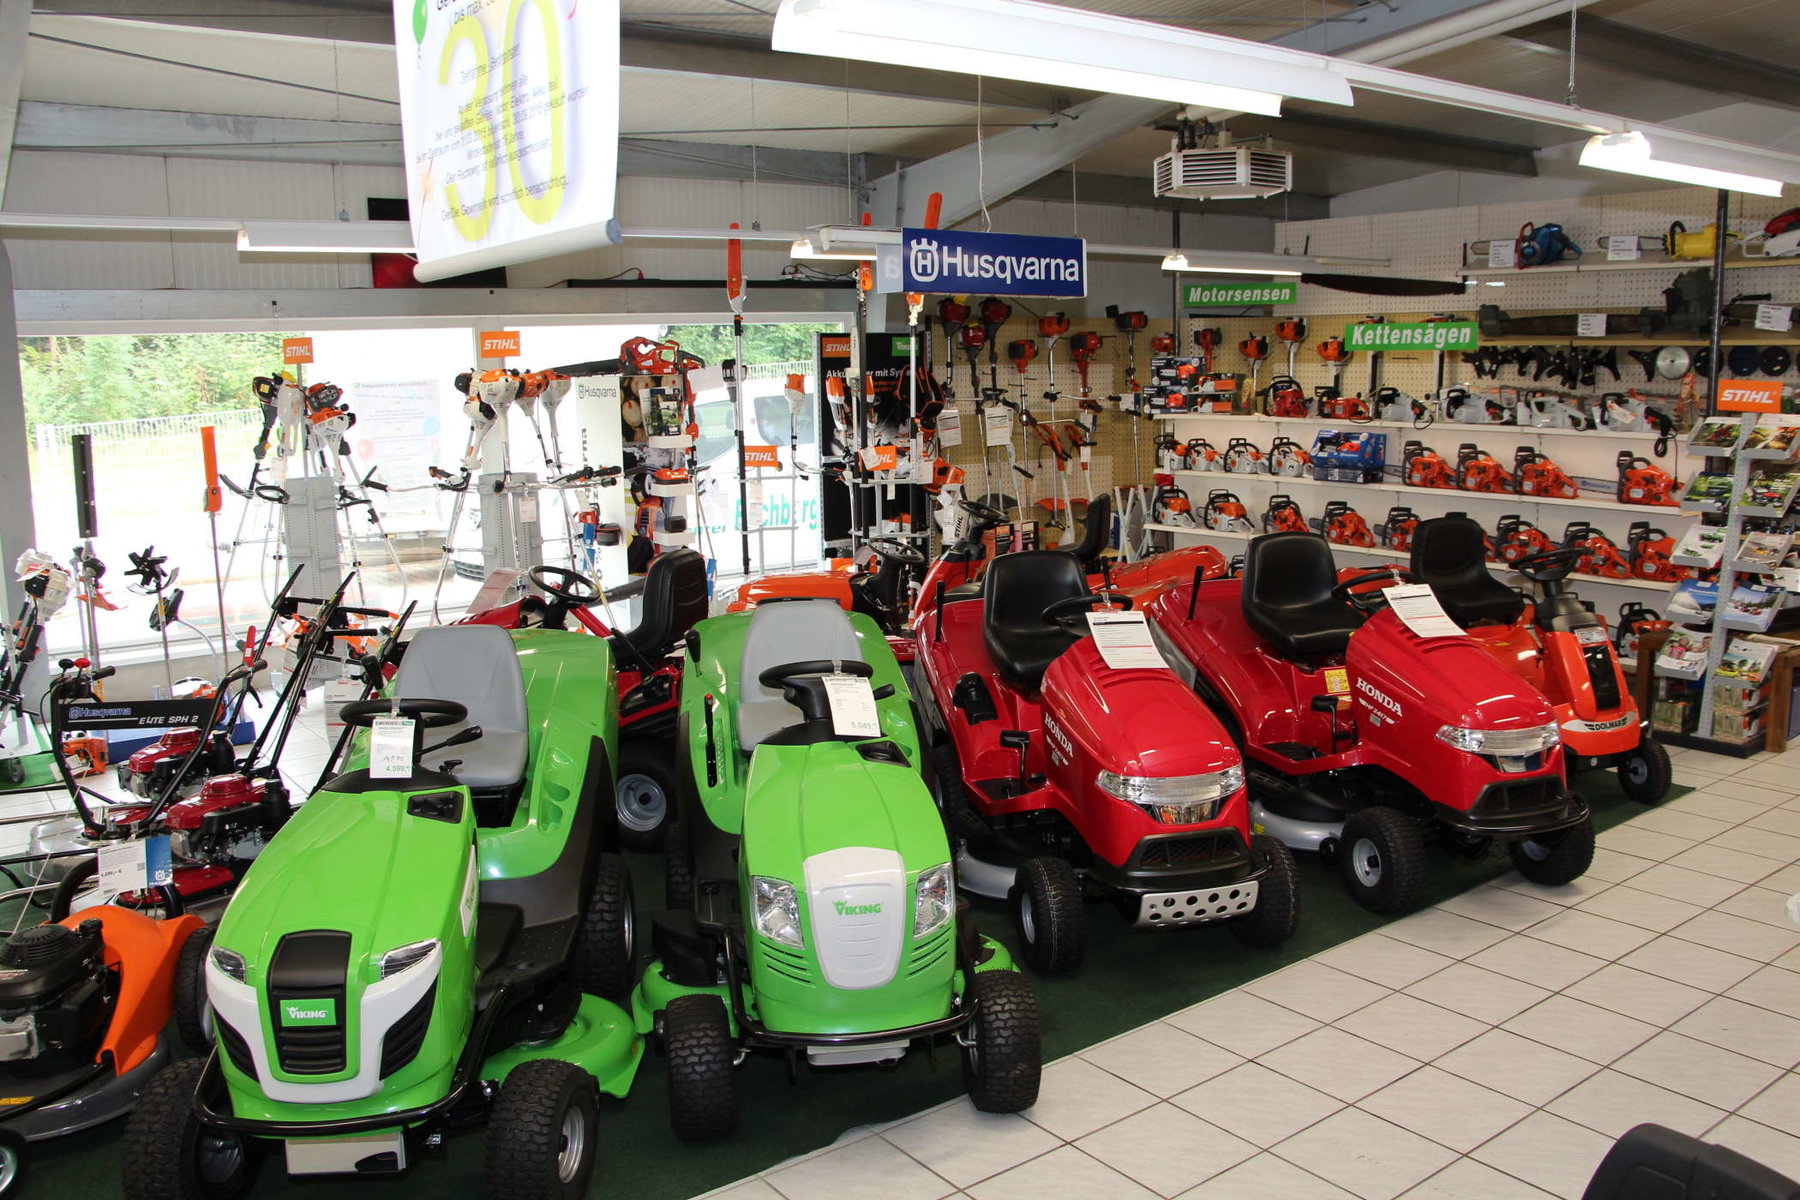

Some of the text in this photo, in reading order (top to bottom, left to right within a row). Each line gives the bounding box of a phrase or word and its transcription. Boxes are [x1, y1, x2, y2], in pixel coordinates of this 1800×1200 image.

[942, 245, 1079, 285] Husqvarna
[1189, 286, 1290, 302] Motorsensen
[1352, 323, 1471, 347] Kettensägen
[285, 345, 311, 357] STIHL
[483, 338, 517, 350] STIHL
[585, 385, 616, 398] Husqvarna
[1721, 389, 1774, 404] STIHL
[954, 515, 963, 538] STIHL
[1356, 677, 1403, 717] HONDA
[80, 707, 131, 718] Husqvarna
[168, 716, 189, 724] SPH
[192, 715, 198, 723] 2
[1594, 718, 1624, 731] DOLMAR
[1045, 712, 1073, 757] HONDA
[834, 901, 882, 916] VIKING
[289, 1008, 327, 1019] VIKING
